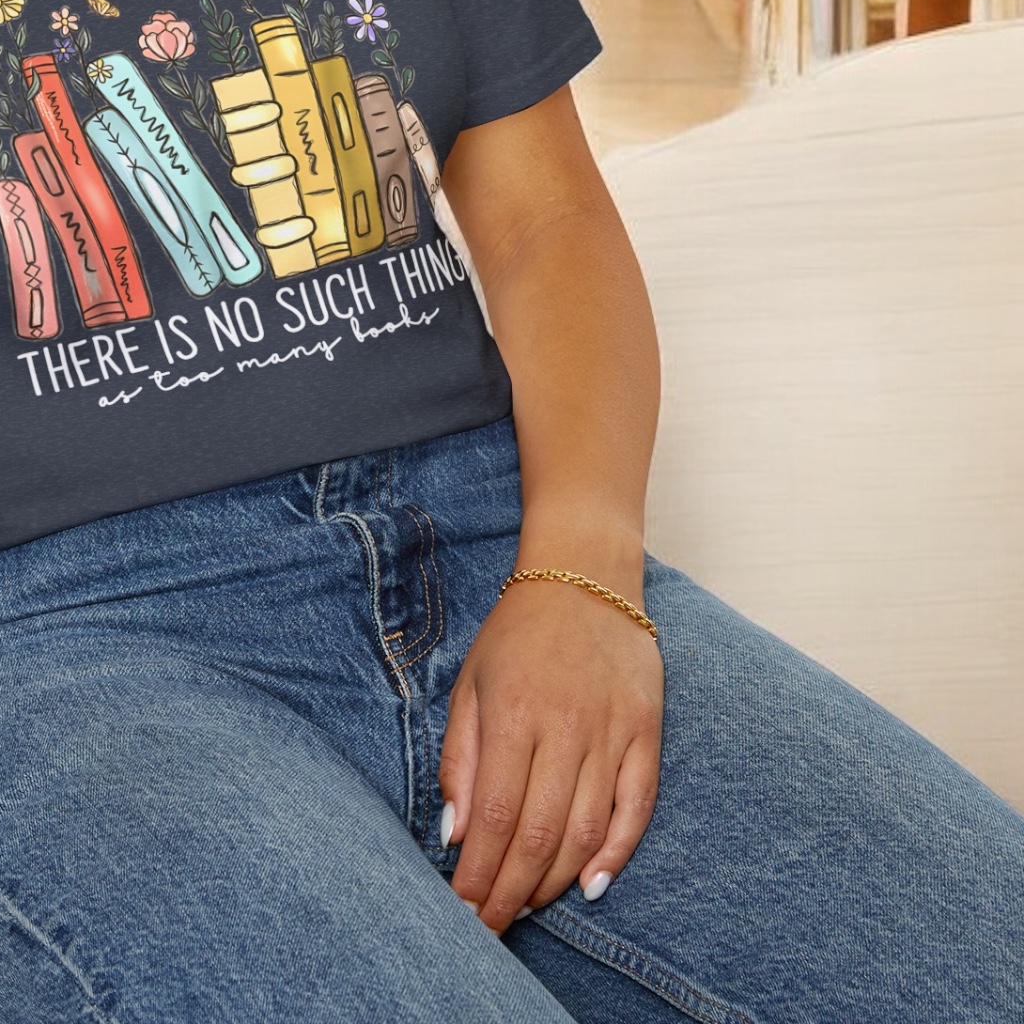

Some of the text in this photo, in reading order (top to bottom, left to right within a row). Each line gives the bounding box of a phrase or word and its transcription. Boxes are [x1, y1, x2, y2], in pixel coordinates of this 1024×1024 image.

[17, 238, 466, 396] THERE IS NO SUCH THING
[97, 303, 440, 408] as too many books
